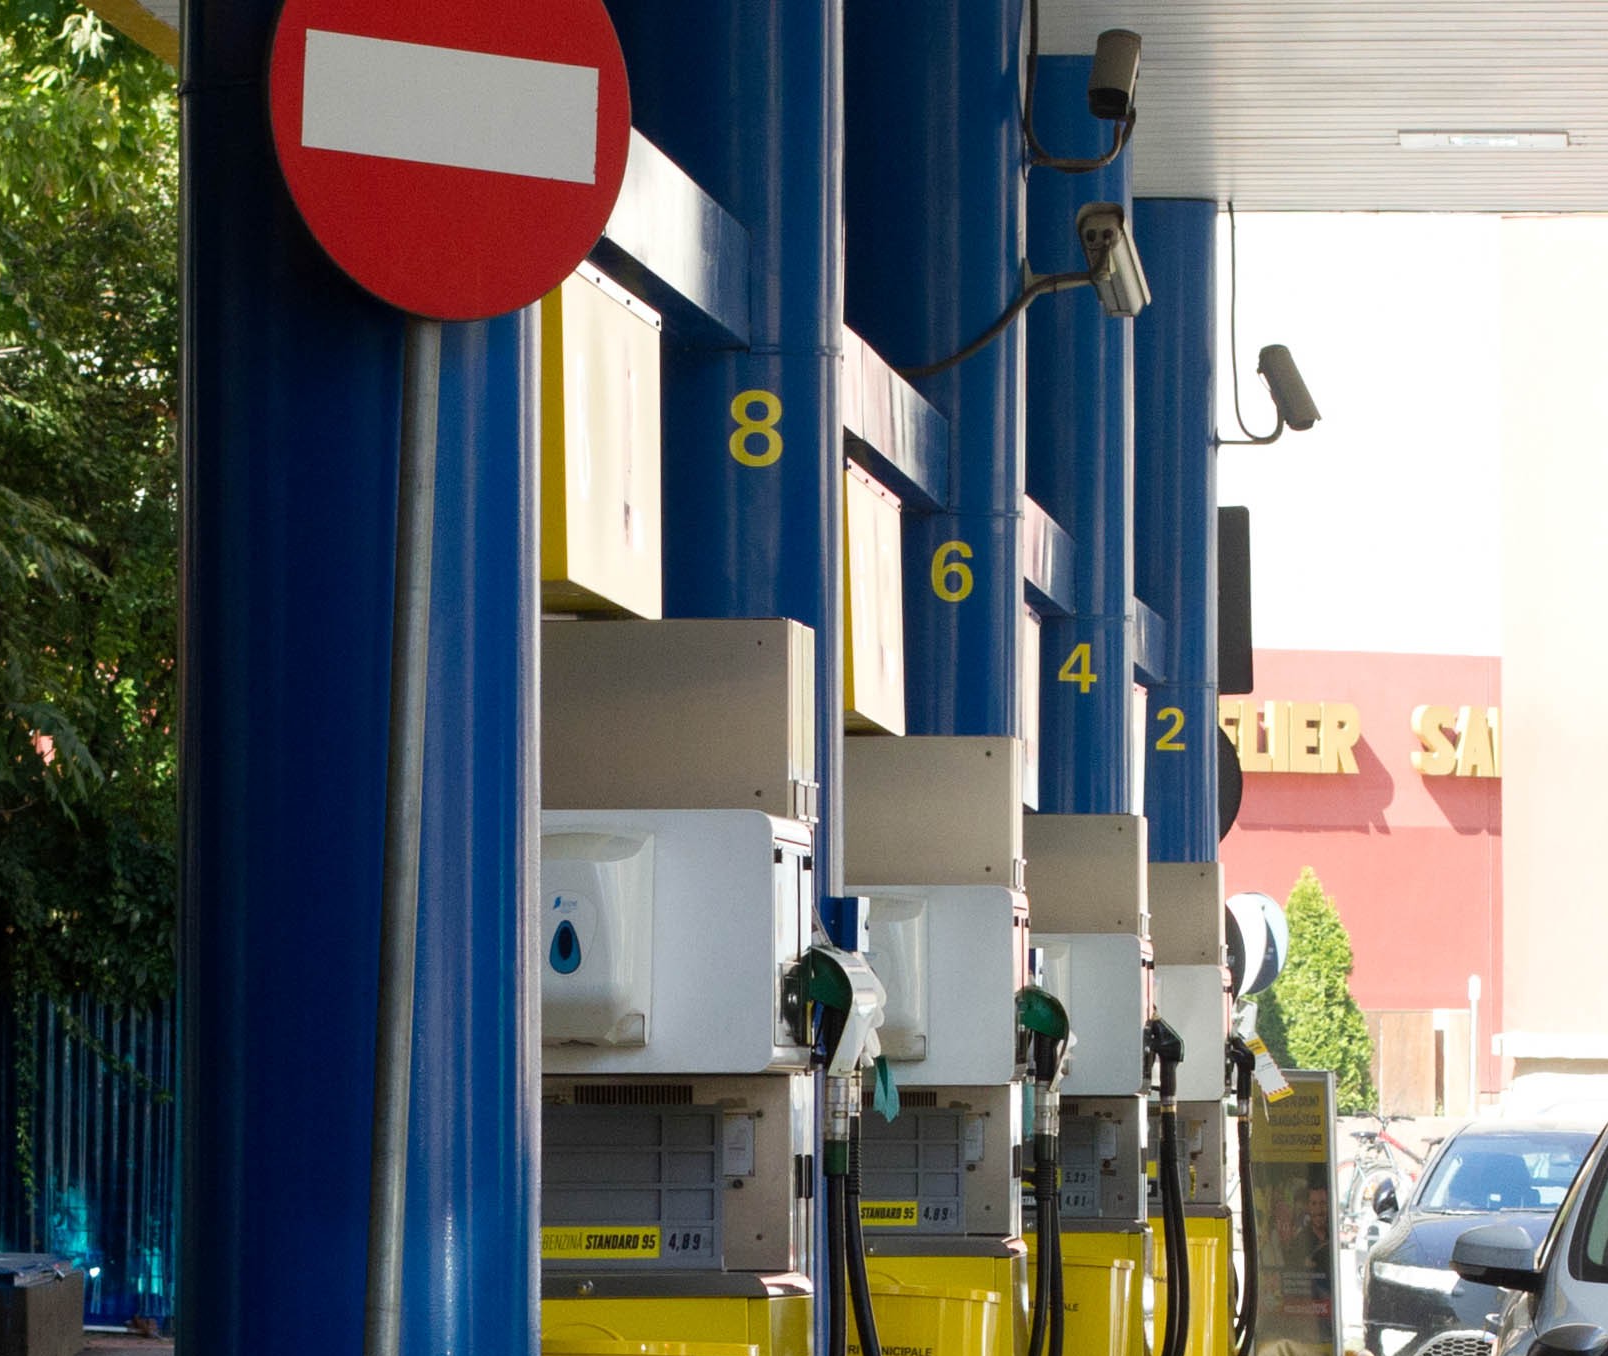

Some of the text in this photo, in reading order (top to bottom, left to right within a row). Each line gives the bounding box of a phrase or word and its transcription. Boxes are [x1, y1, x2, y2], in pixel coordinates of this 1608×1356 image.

[729, 390, 783, 467] 8
[931, 541, 974, 602] 6
[1058, 644, 1098, 692] 4
[1155, 707, 1186, 750] 2
[861, 1207, 901, 1219] STANDARD
[903, 1207, 914, 1219] 95
[585, 1234, 638, 1250] STANDARD
[641, 1234, 656, 1249] 95
